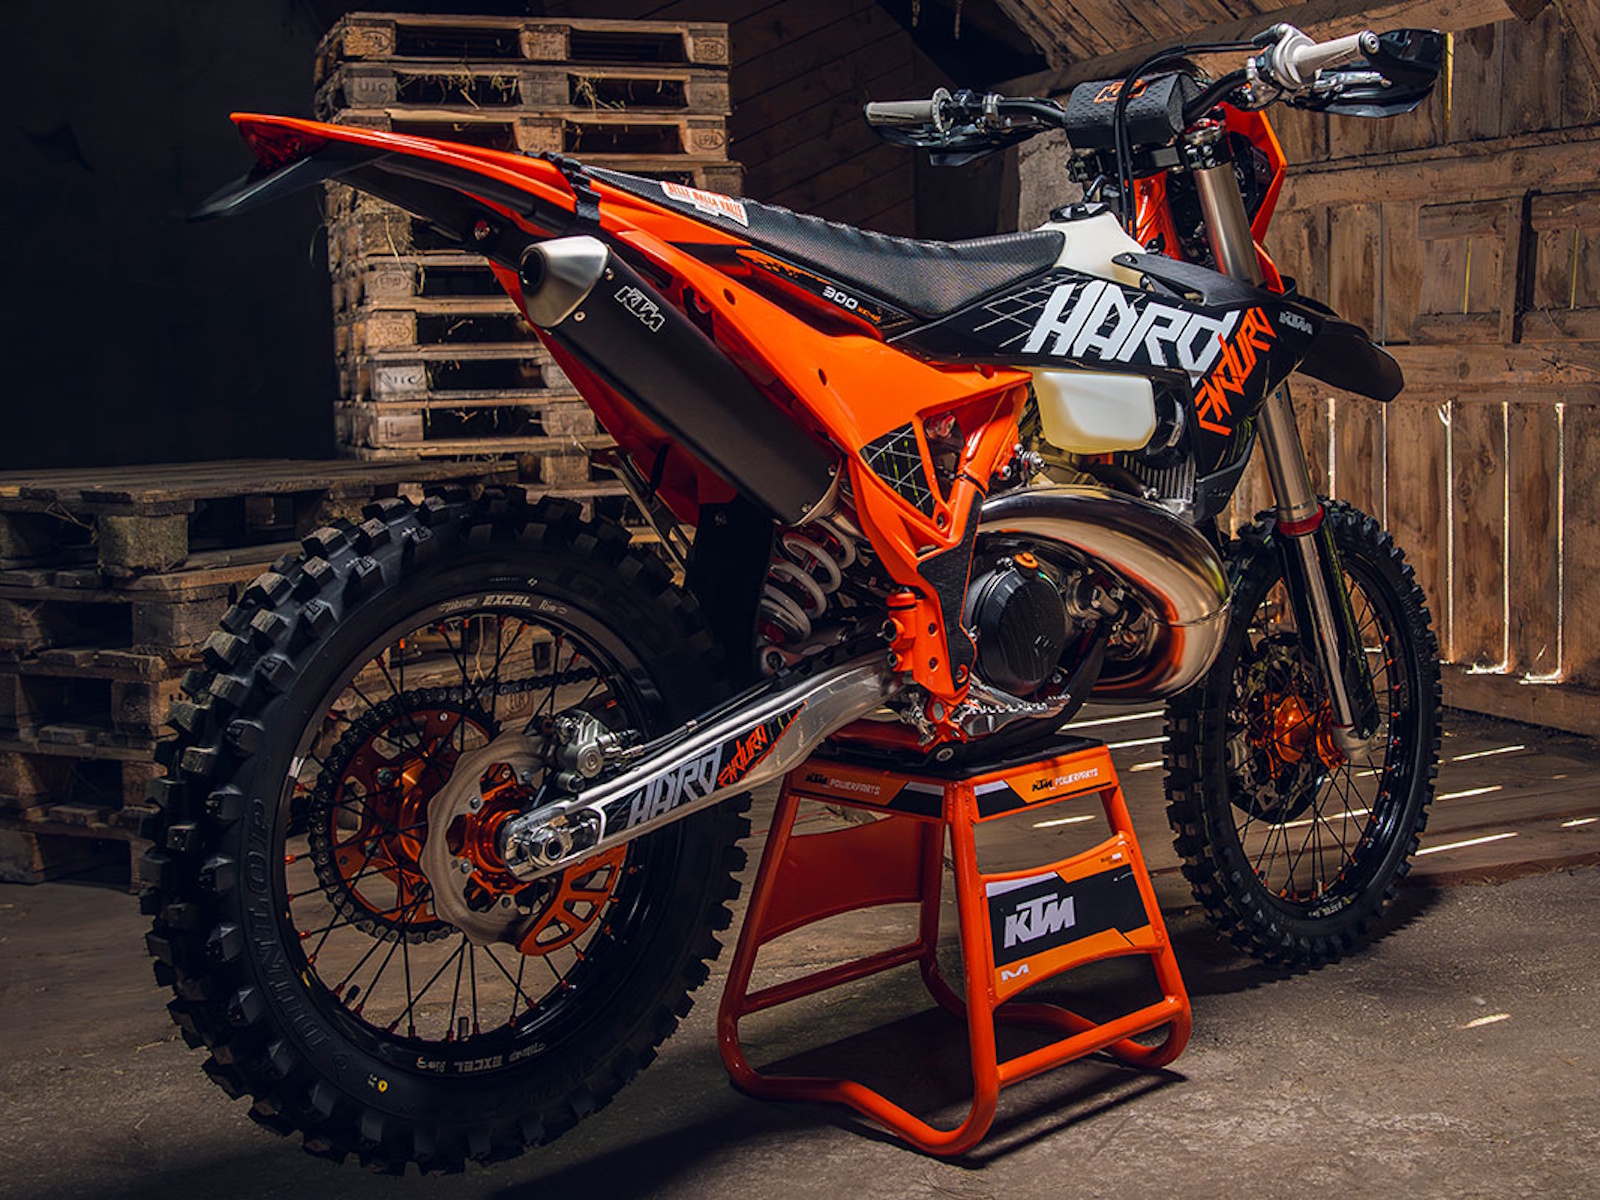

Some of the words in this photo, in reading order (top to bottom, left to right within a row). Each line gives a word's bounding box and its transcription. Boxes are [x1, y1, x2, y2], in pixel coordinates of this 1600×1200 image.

[613, 285, 666, 333] KTM
[822, 285, 859, 311] 300
[1021, 280, 1242, 387] HARD
[1279, 310, 1313, 335] KTM
[482, 593, 532, 608] EXCEL
[627, 743, 725, 830] HARD
[805, 772, 829, 786] KTM
[829, 777, 882, 796] POWERPARTS
[1031, 777, 1053, 792] KTM
[1054, 767, 1099, 787] POWERPARTS
[1003, 892, 1076, 949] KTM
[453, 1054, 504, 1073] EXCEL
